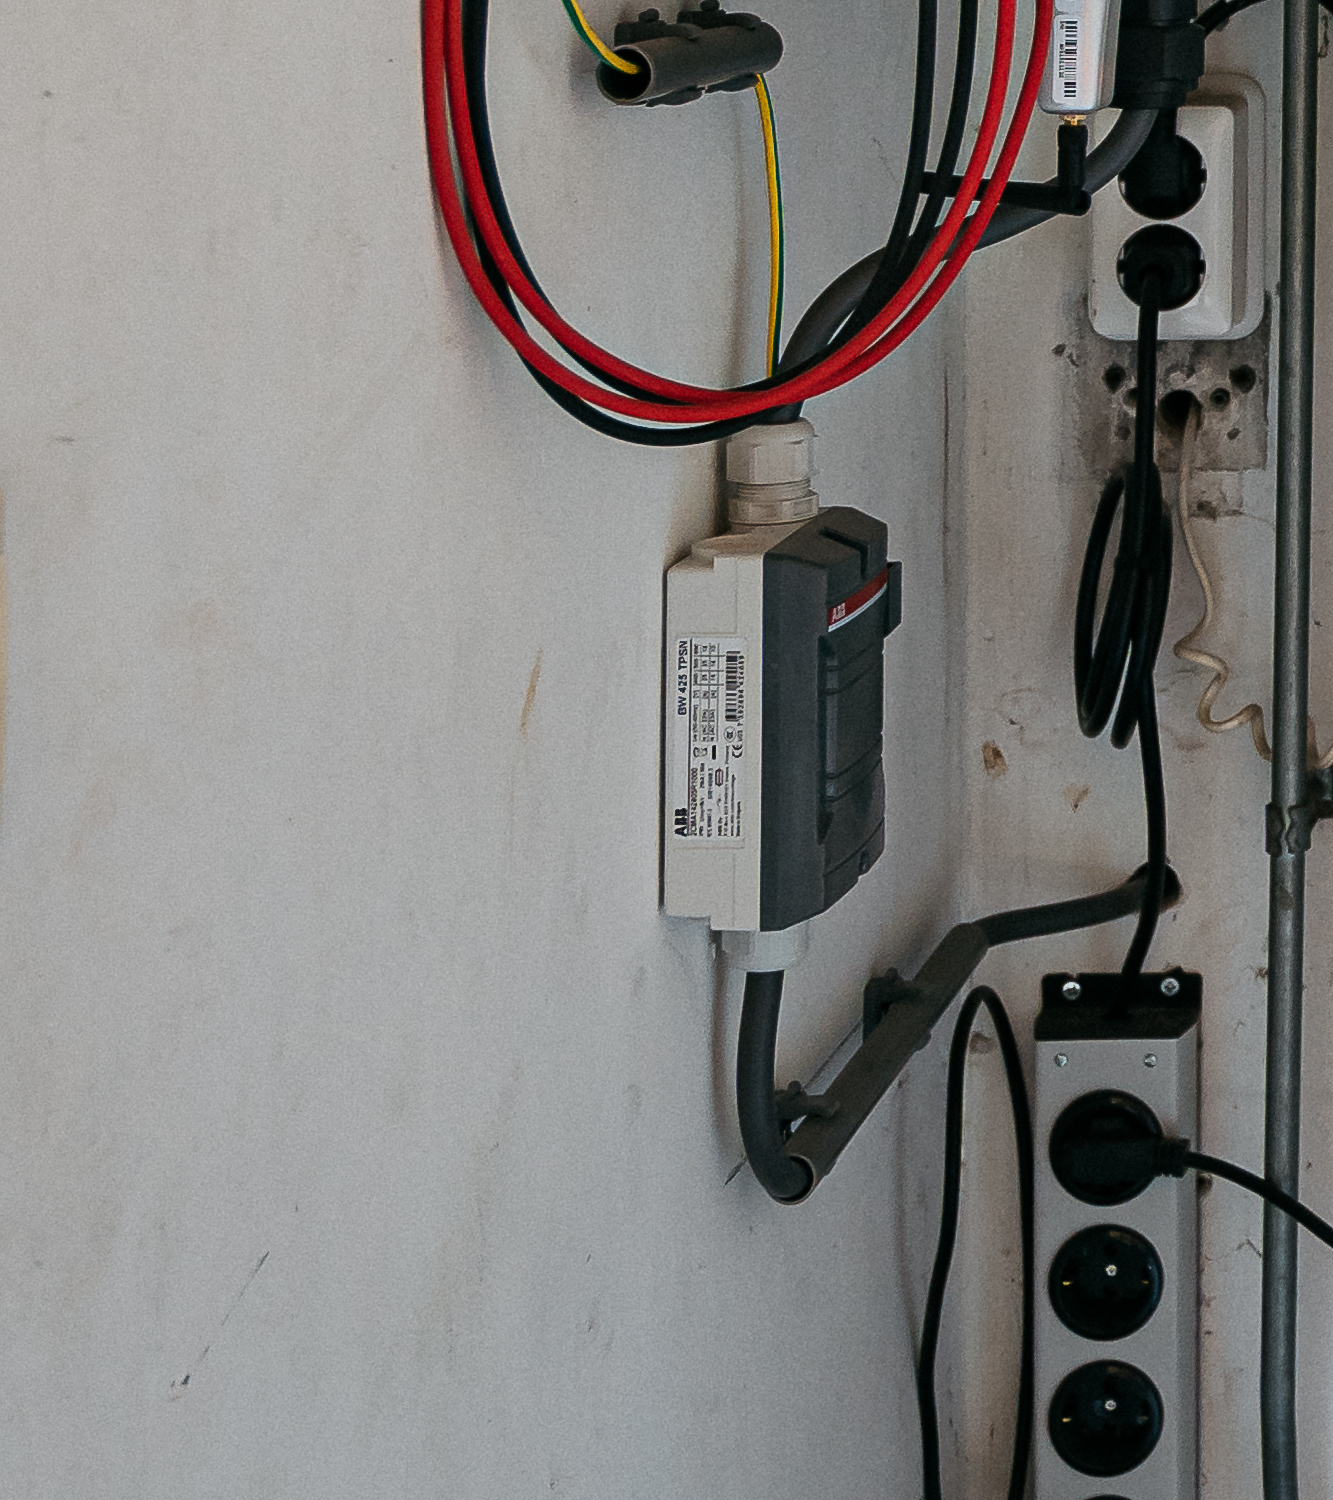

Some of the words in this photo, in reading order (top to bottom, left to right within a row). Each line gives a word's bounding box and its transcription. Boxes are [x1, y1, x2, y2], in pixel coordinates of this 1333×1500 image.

[677, 640, 688, 671] TPSN
[677, 674, 688, 694] 425
[674, 807, 688, 837] ABB
